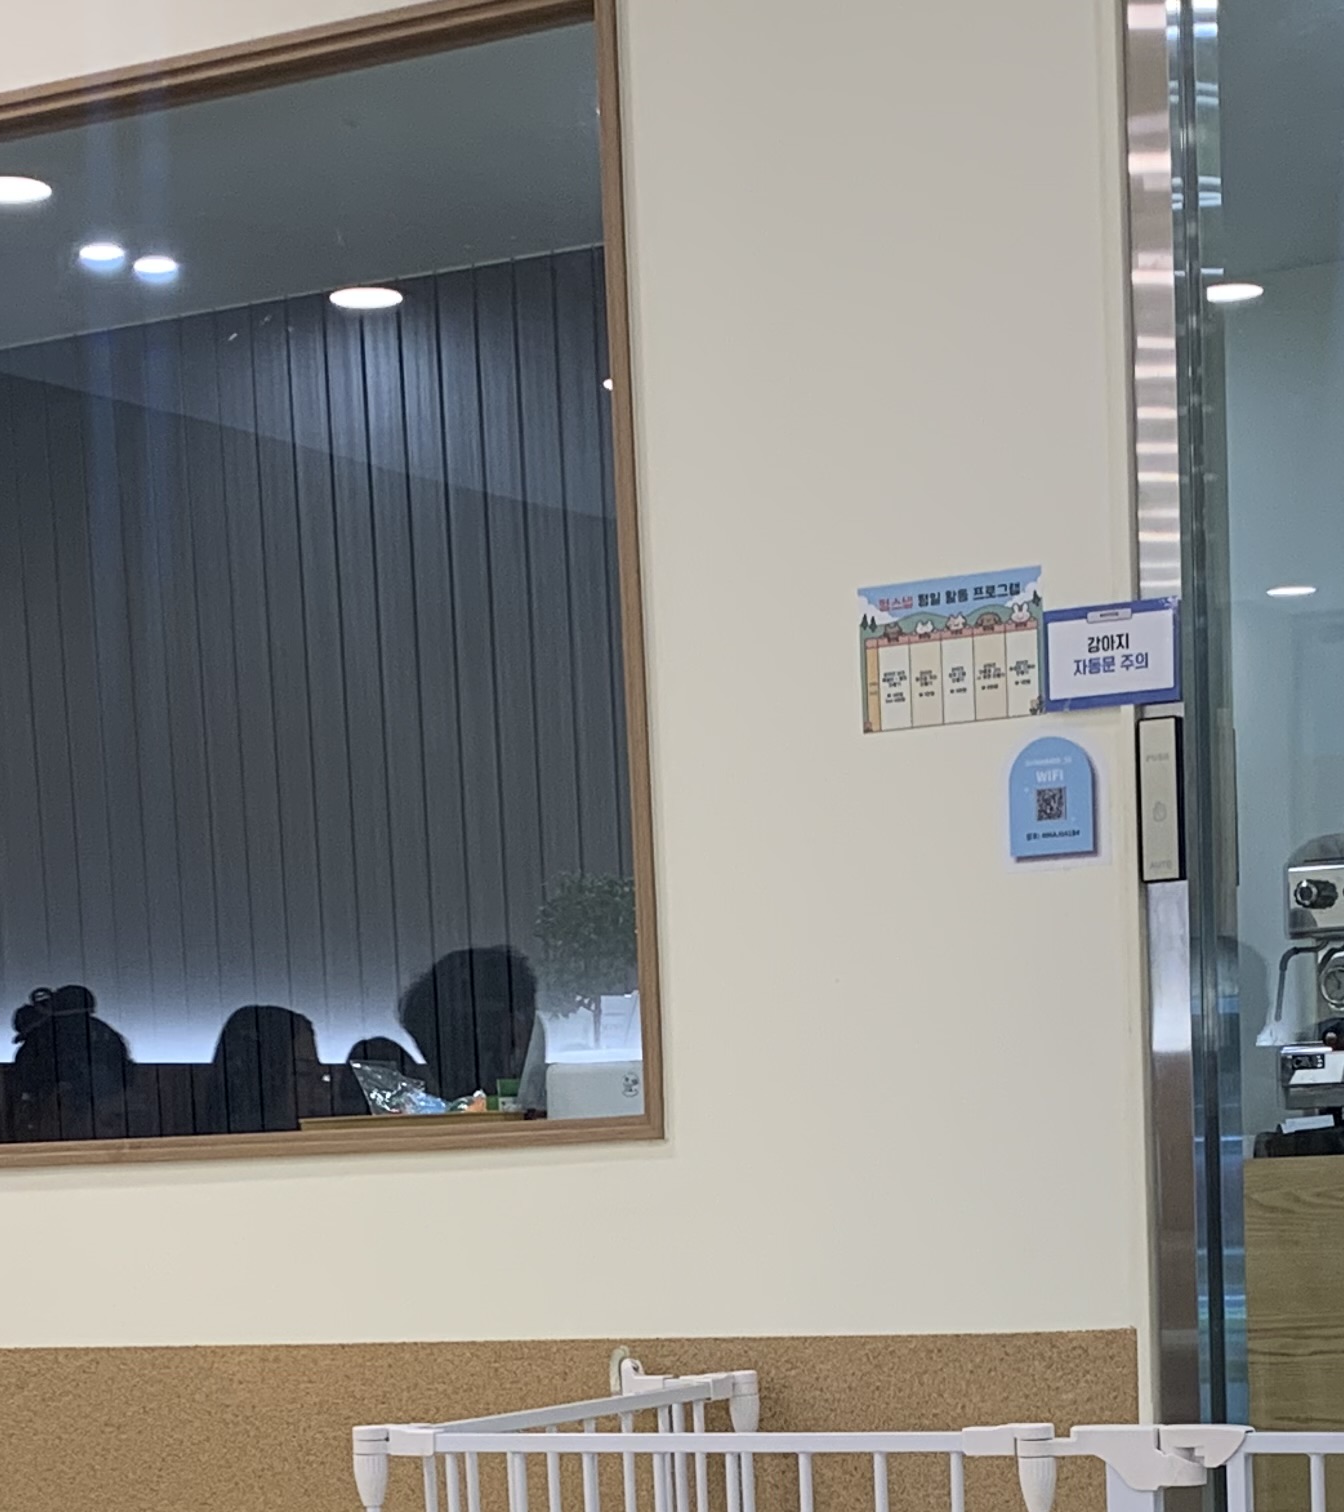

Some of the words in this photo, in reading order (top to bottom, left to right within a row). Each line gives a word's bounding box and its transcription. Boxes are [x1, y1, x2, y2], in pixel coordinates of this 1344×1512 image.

[973, 582, 1021, 601] 프로그램
[1087, 632, 1129, 653] 강아지
[1073, 656, 1115, 676] 자동문
[1120, 652, 1149, 671] 주의
